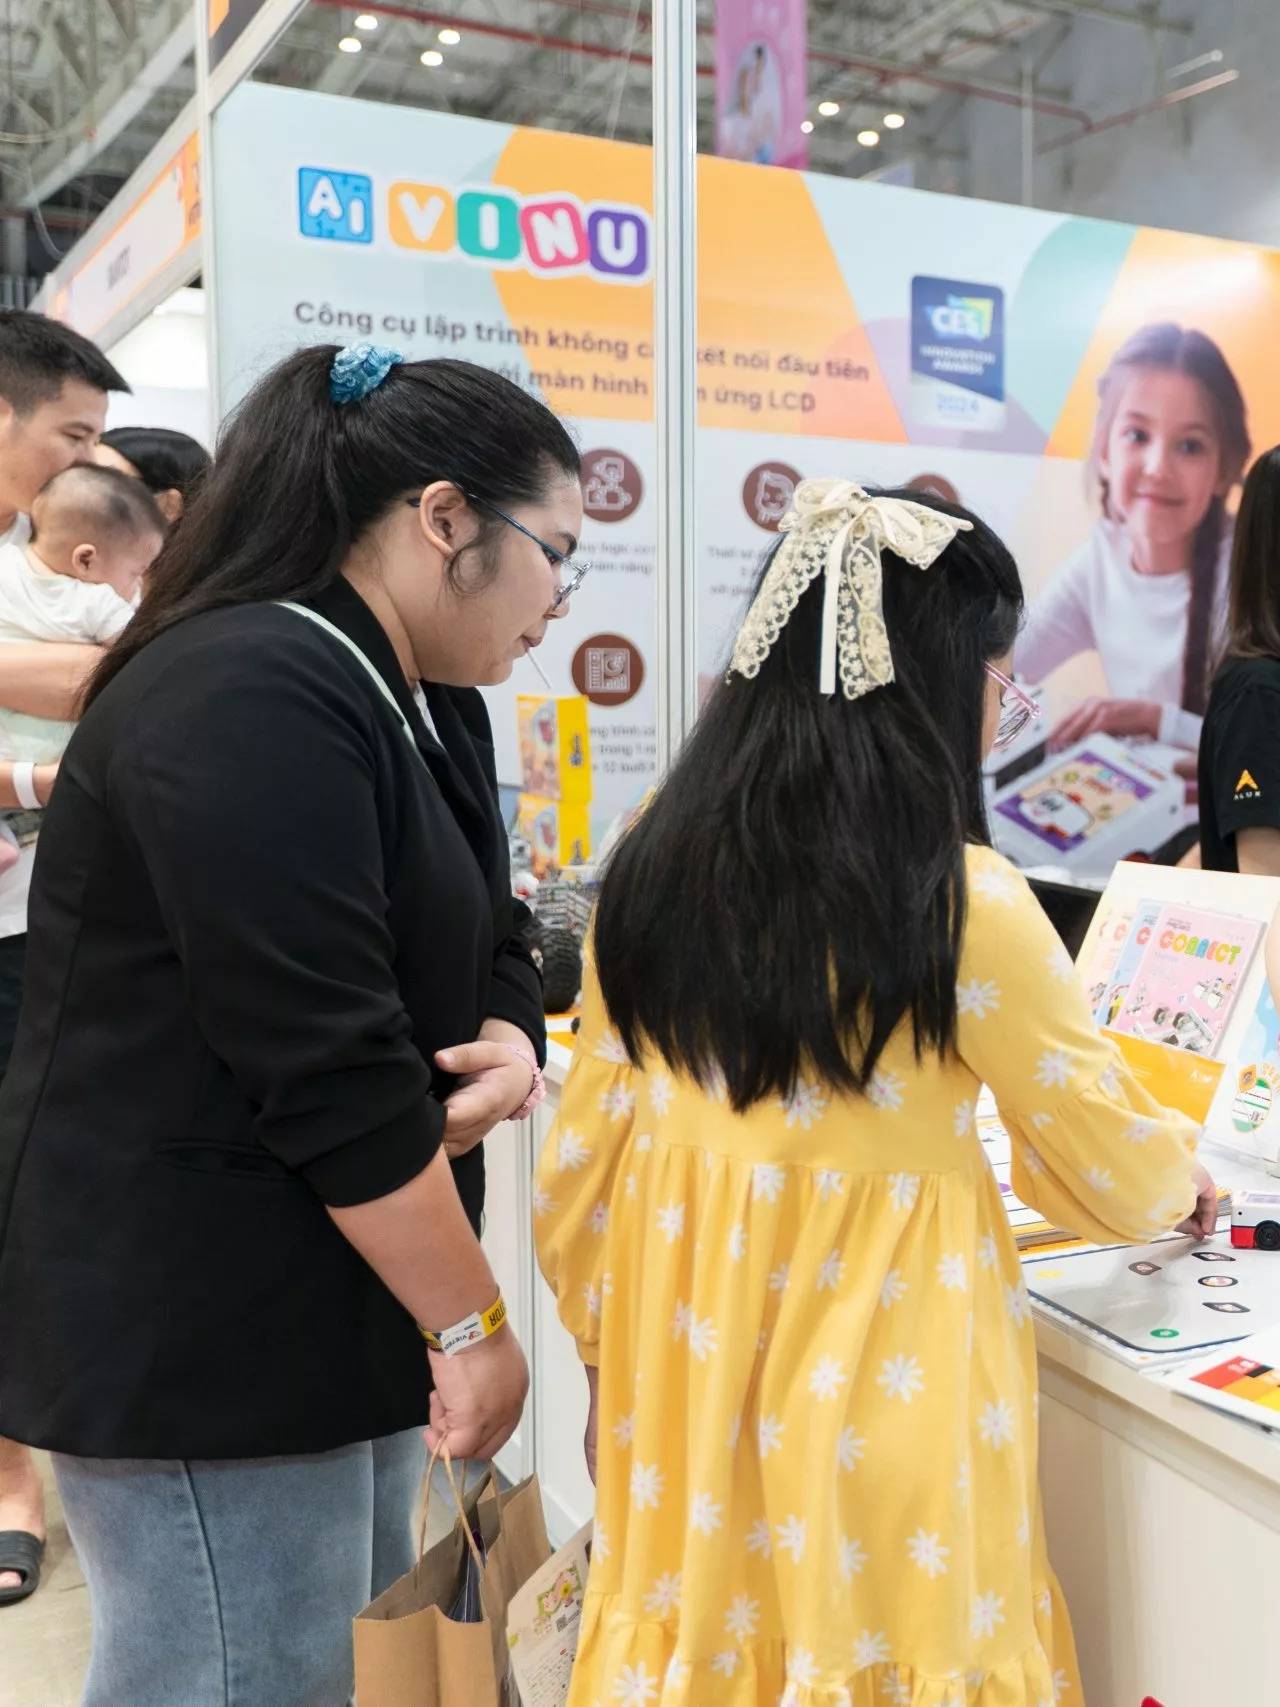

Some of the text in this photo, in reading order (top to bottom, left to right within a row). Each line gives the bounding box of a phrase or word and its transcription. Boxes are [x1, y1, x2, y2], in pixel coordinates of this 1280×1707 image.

[396, 188, 642, 270] VINU
[295, 302, 373, 334] Công
[383, 316, 416, 337] cụ
[426, 314, 466, 342] lập
[475, 322, 539, 347] trình
[549, 330, 629, 360] không
[826, 357, 870, 381] tiên
[592, 373, 647, 395] hình
[715, 382, 762, 410] ứng
[768, 390, 816, 413] LCD
